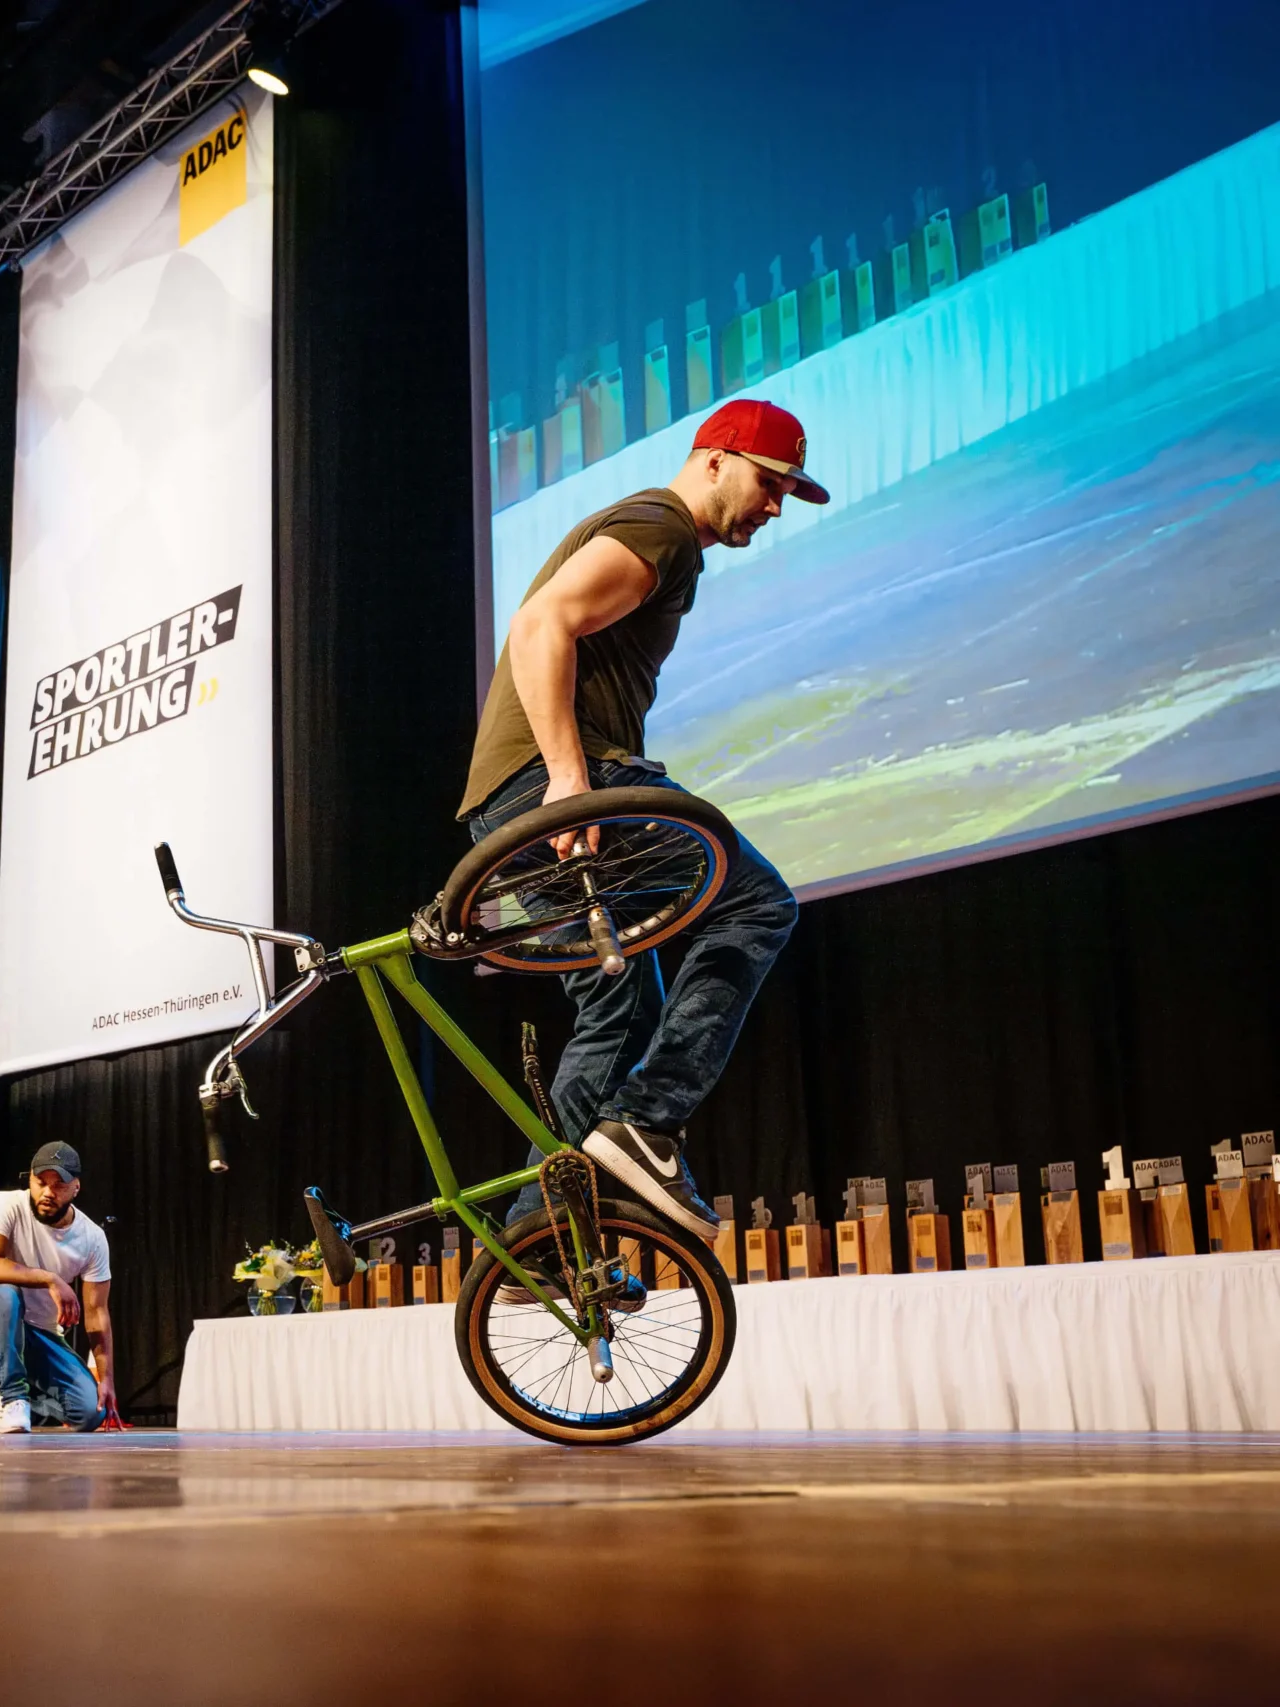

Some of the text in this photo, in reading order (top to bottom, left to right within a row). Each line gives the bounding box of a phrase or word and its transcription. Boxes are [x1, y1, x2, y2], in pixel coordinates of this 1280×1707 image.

[183, 117, 243, 187] ADAC
[34, 601, 234, 724] SPORTLER-
[33, 668, 188, 775] EHRUNG
[92, 984, 243, 1031] ADAC Hessen-Thüringen e.V.
[1244, 1133, 1272, 1146] ADAC
[1102, 1145, 1131, 1191] 1
[1135, 1161, 1159, 1171] ADAC
[1159, 1158, 1180, 1168] ADAC
[1218, 1152, 1241, 1162] ADAC
[967, 1165, 990, 1177] ADAC
[1051, 1164, 1073, 1173] ADAC
[380, 1237, 397, 1265] 2
[418, 1243, 432, 1265] 3
